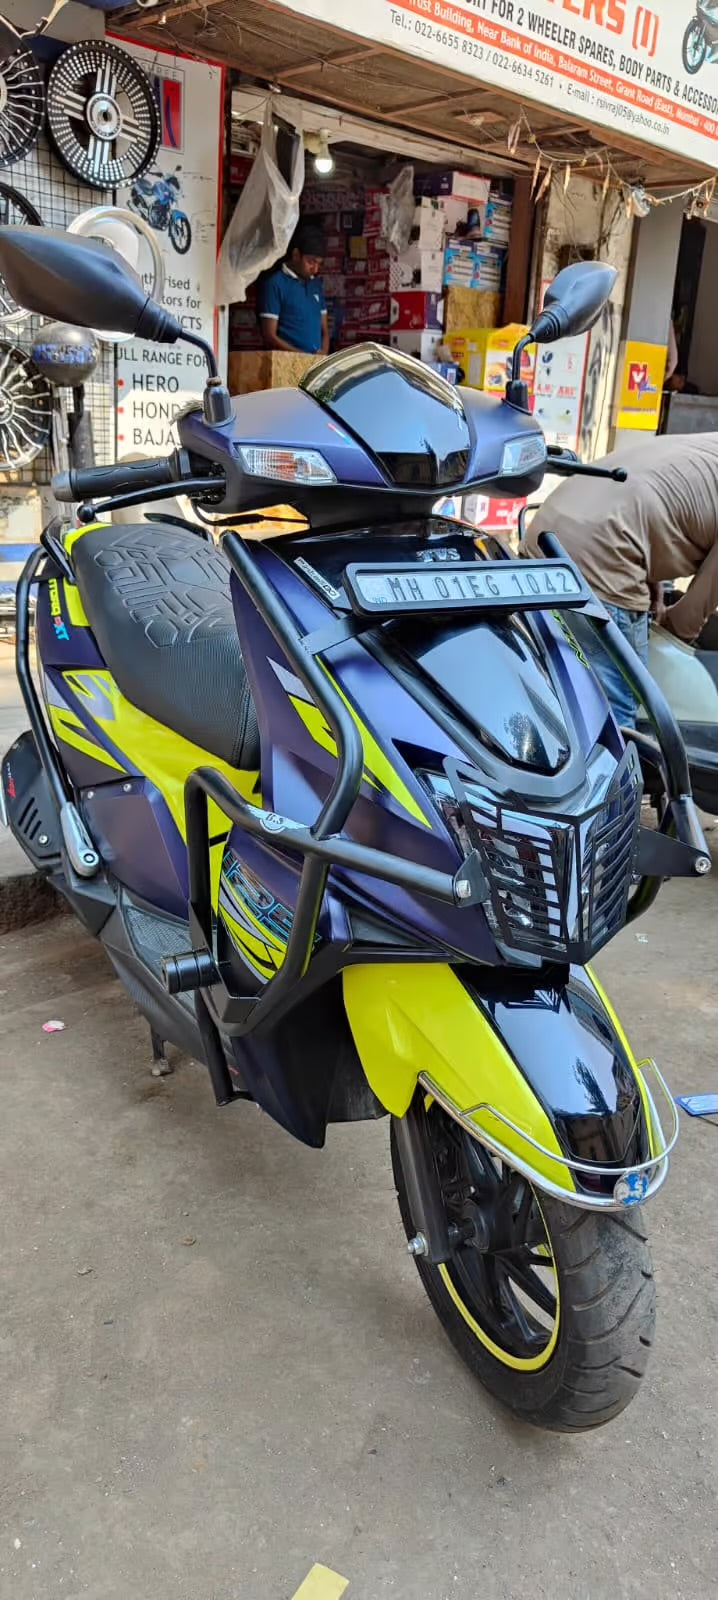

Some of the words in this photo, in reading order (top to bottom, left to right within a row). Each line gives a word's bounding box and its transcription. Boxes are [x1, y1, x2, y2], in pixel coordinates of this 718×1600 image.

[390, 8, 412, 31] Tel.:
[414, 20, 460, 50] 022-6655
[461, 40, 484, 60] 8323
[492, 52, 533, 79] 022-6634
[535, 70, 555, 88] 5261
[567, 83, 590, 103] E-mail
[434, 2, 475, 33] Building,
[477, 20, 500, 40] Near
[500, 30, 522, 49] Bank
[523, 40, 533, 55] of
[534, 44, 556, 67] India,
[589, 68, 614, 92] Street,
[615, 81, 636, 101] Grant
[635, 89, 655, 107] Road
[490, 0, 515, 22] FOR
[516, 8, 525, 26] 2
[527, 11, 577, 50] WHEELER
[578, 35, 617, 71] SPARES,
[619, 54, 645, 80] BODY
[645, 66, 672, 93] PARTS
[673, 80, 681, 97] &
[681, 84, 718, 115] ACCESSO
[142, 349, 183, 366] RANGE
[132, 372, 179, 393] HERO
[133, 400, 181, 419] HOND
[133, 428, 183, 446] BAJA
[423, 547, 461, 563] TVS
[386, 576, 425, 601] MH
[433, 574, 500, 599] 01EG
[511, 571, 573, 596] 1042
